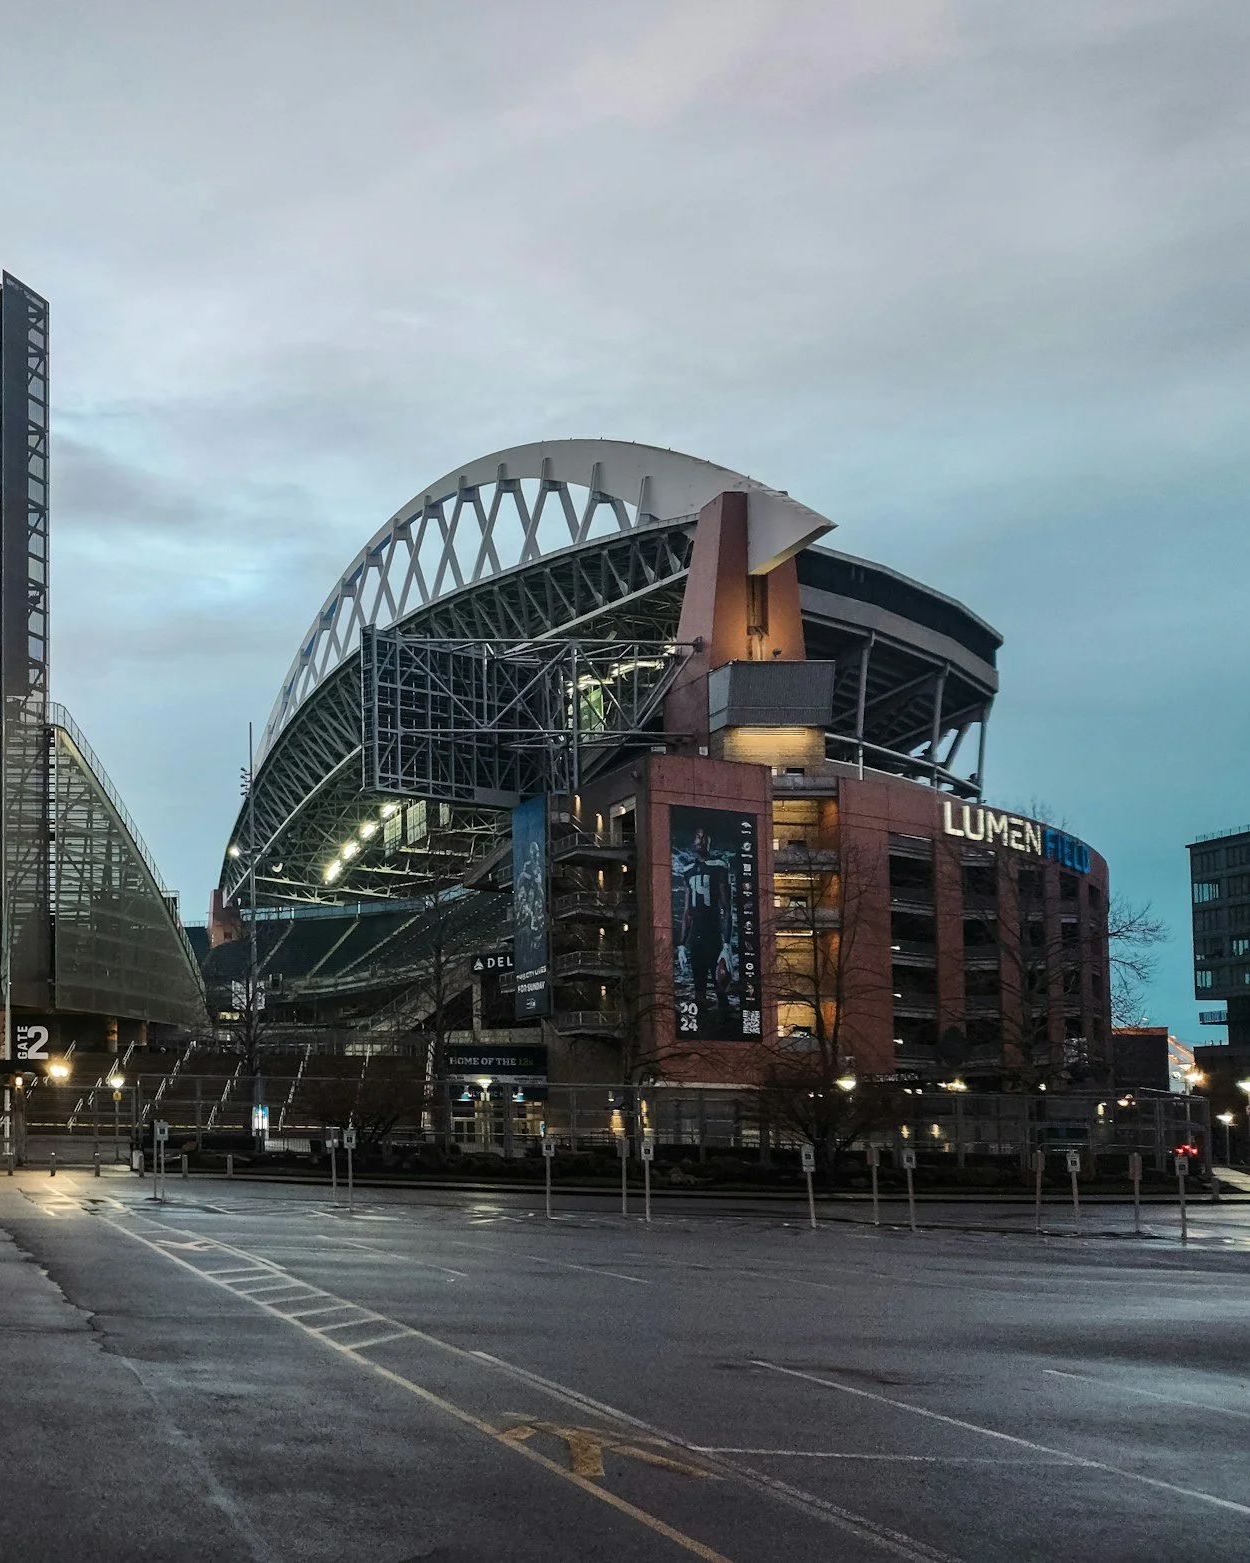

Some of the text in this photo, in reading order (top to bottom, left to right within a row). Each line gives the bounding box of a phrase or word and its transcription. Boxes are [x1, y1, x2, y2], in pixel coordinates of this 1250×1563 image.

[943, 801, 1091, 874] LUMEN FIELD
[688, 874, 711, 907] 14
[680, 1015, 699, 1032] 24
[17, 1025, 49, 1060] GATE 2
[449, 1057, 480, 1066] HOME
[481, 1057, 495, 1066] OF
[495, 1057, 517, 1066] THE
